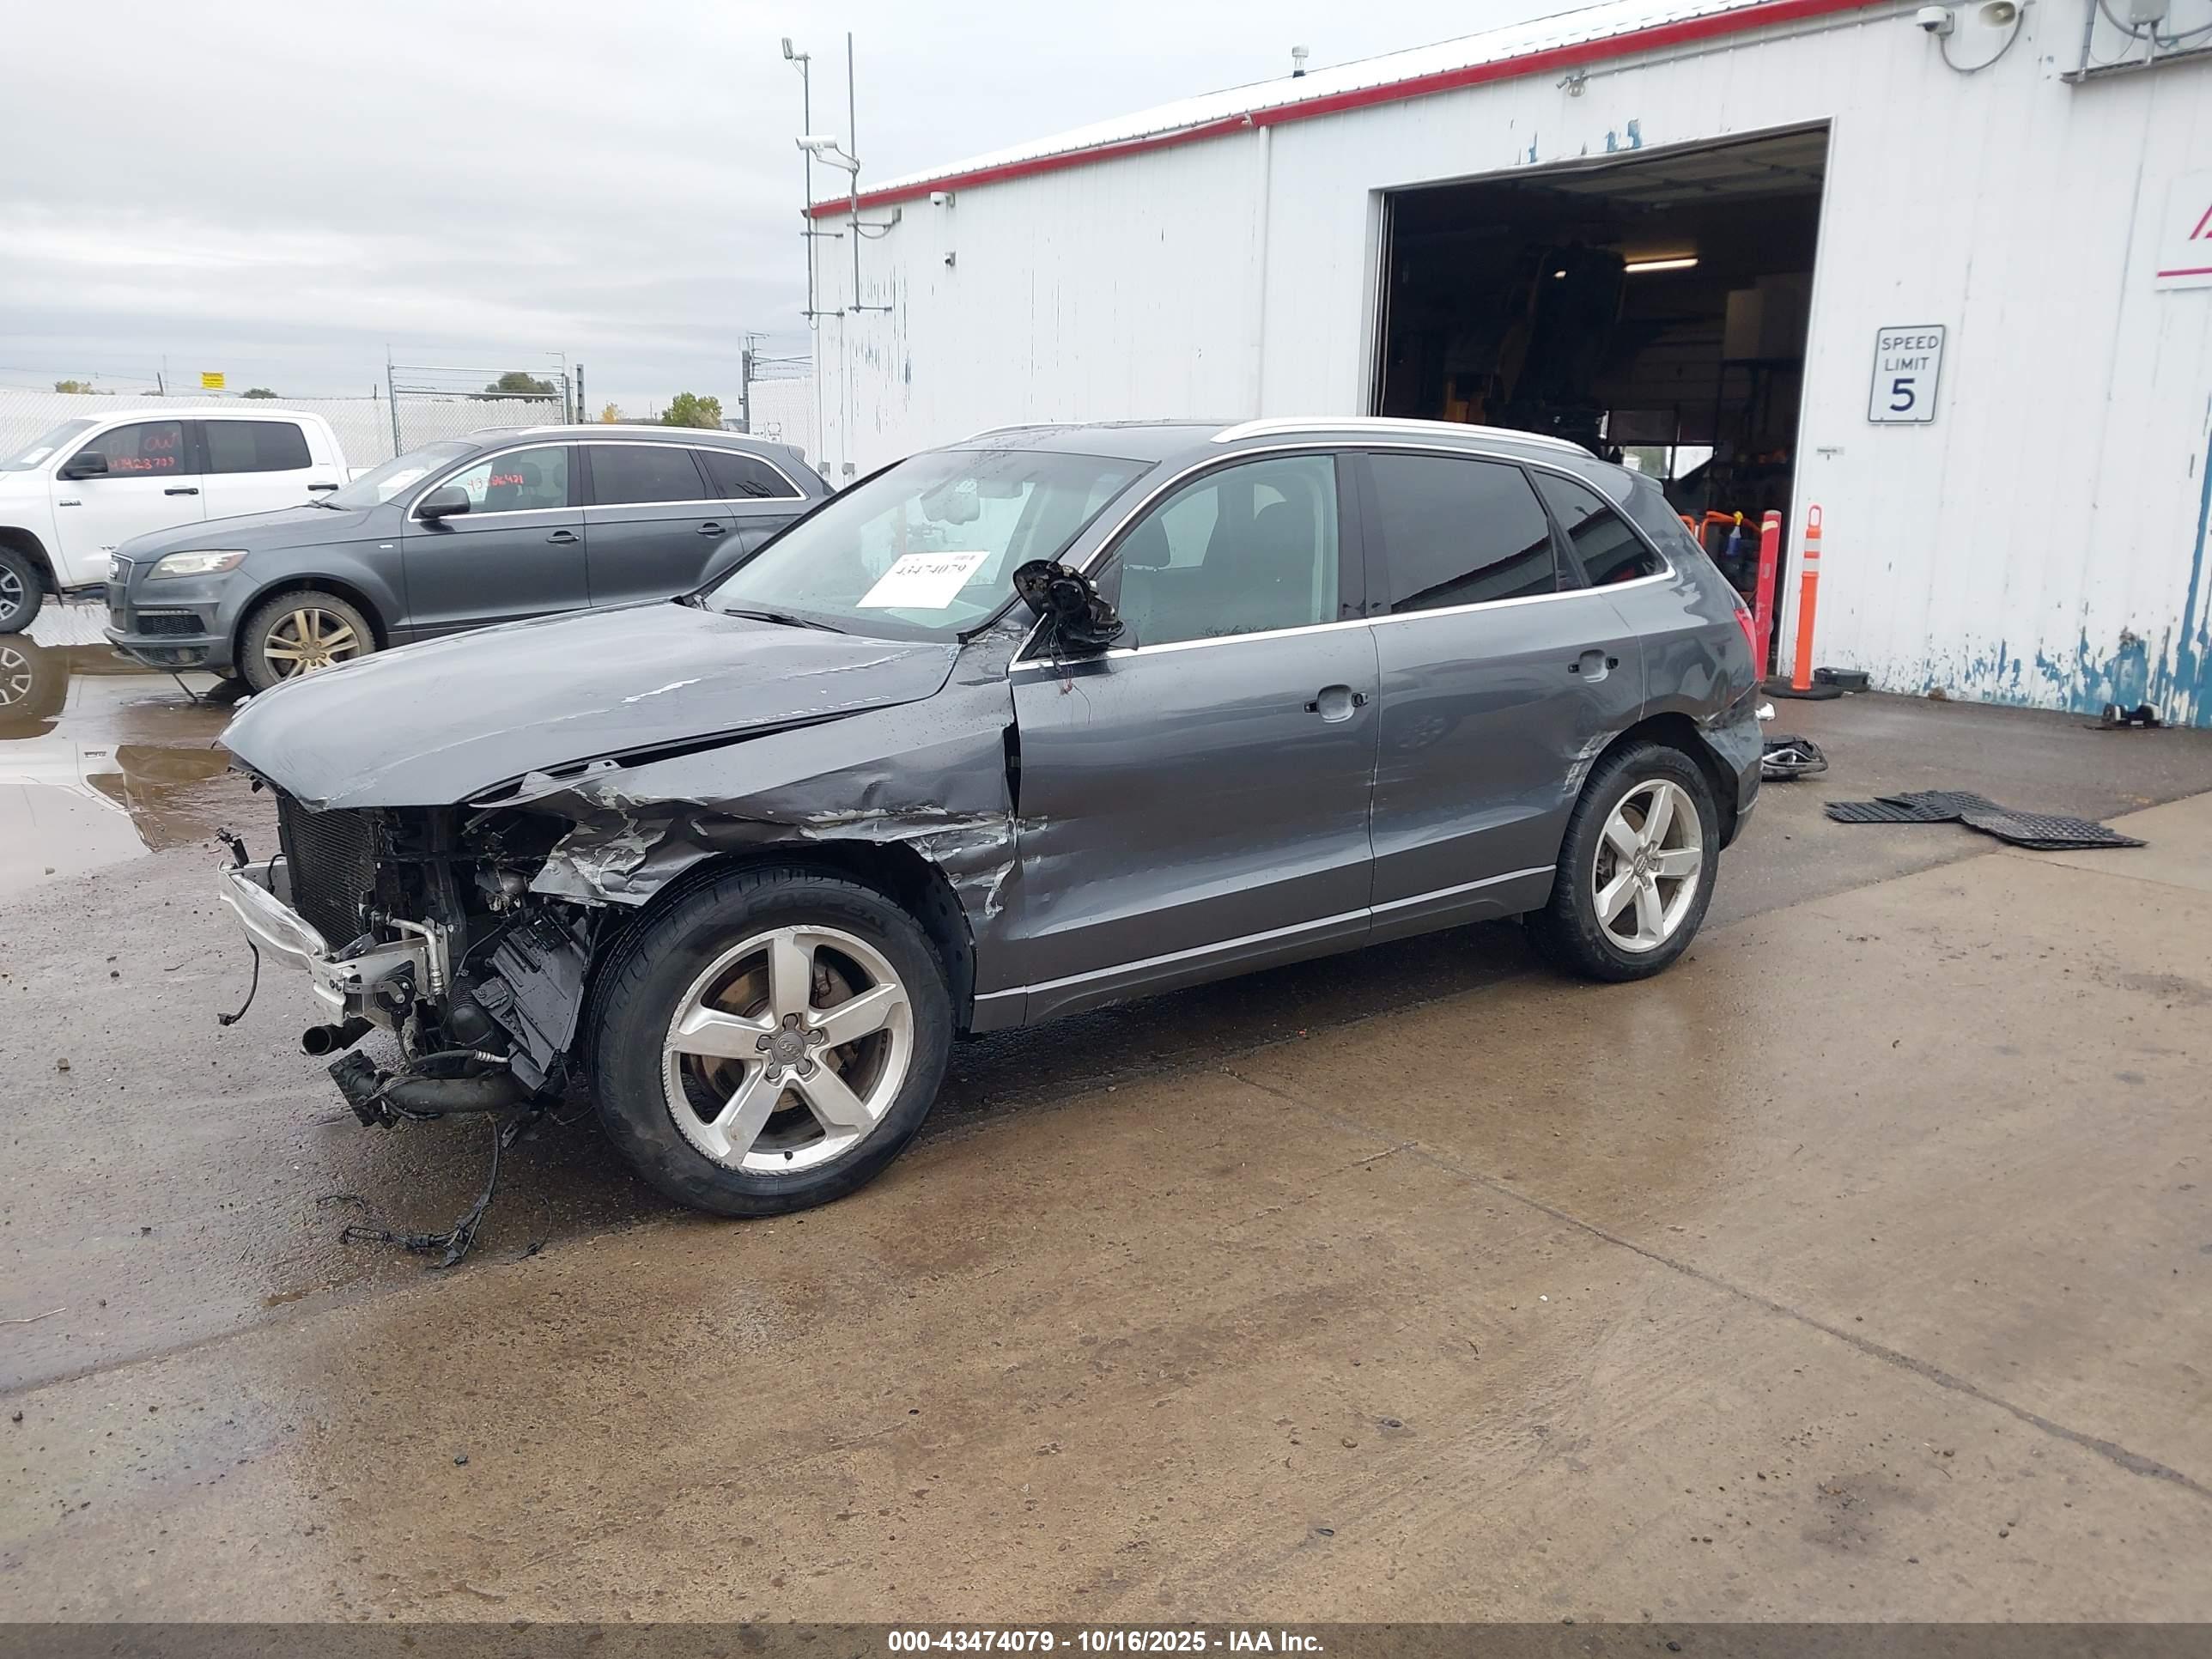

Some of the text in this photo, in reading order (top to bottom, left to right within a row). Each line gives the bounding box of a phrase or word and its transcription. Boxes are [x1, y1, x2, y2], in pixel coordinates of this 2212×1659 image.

[1881, 336, 1939, 350] SPEED
[1884, 356, 1929, 371] LIMIT
[1889, 378, 1915, 411] 5
